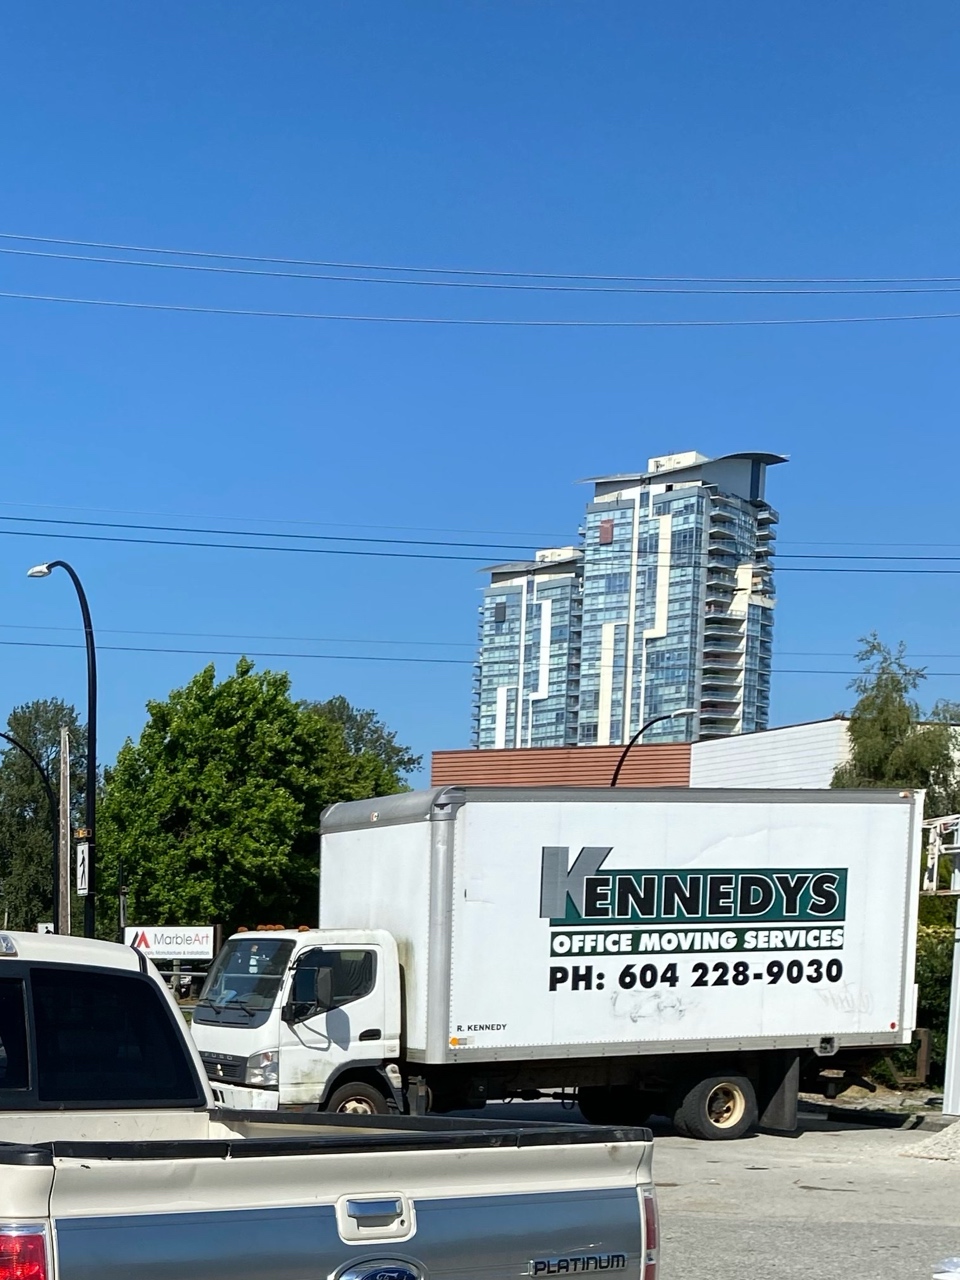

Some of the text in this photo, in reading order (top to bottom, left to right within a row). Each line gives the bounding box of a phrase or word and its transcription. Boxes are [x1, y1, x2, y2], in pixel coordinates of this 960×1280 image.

[539, 846, 841, 918] KENNEDYS
[153, 933, 210, 946] MarbleArt
[552, 928, 845, 954] OFFICE MOVING SERVICES
[548, 957, 844, 992] PH: 604 228-9030
[456, 1023, 508, 1032] R. KENNEDY
[204, 1052, 233, 1061] FUSO
[534, 1254, 626, 1276] PLATINUM
